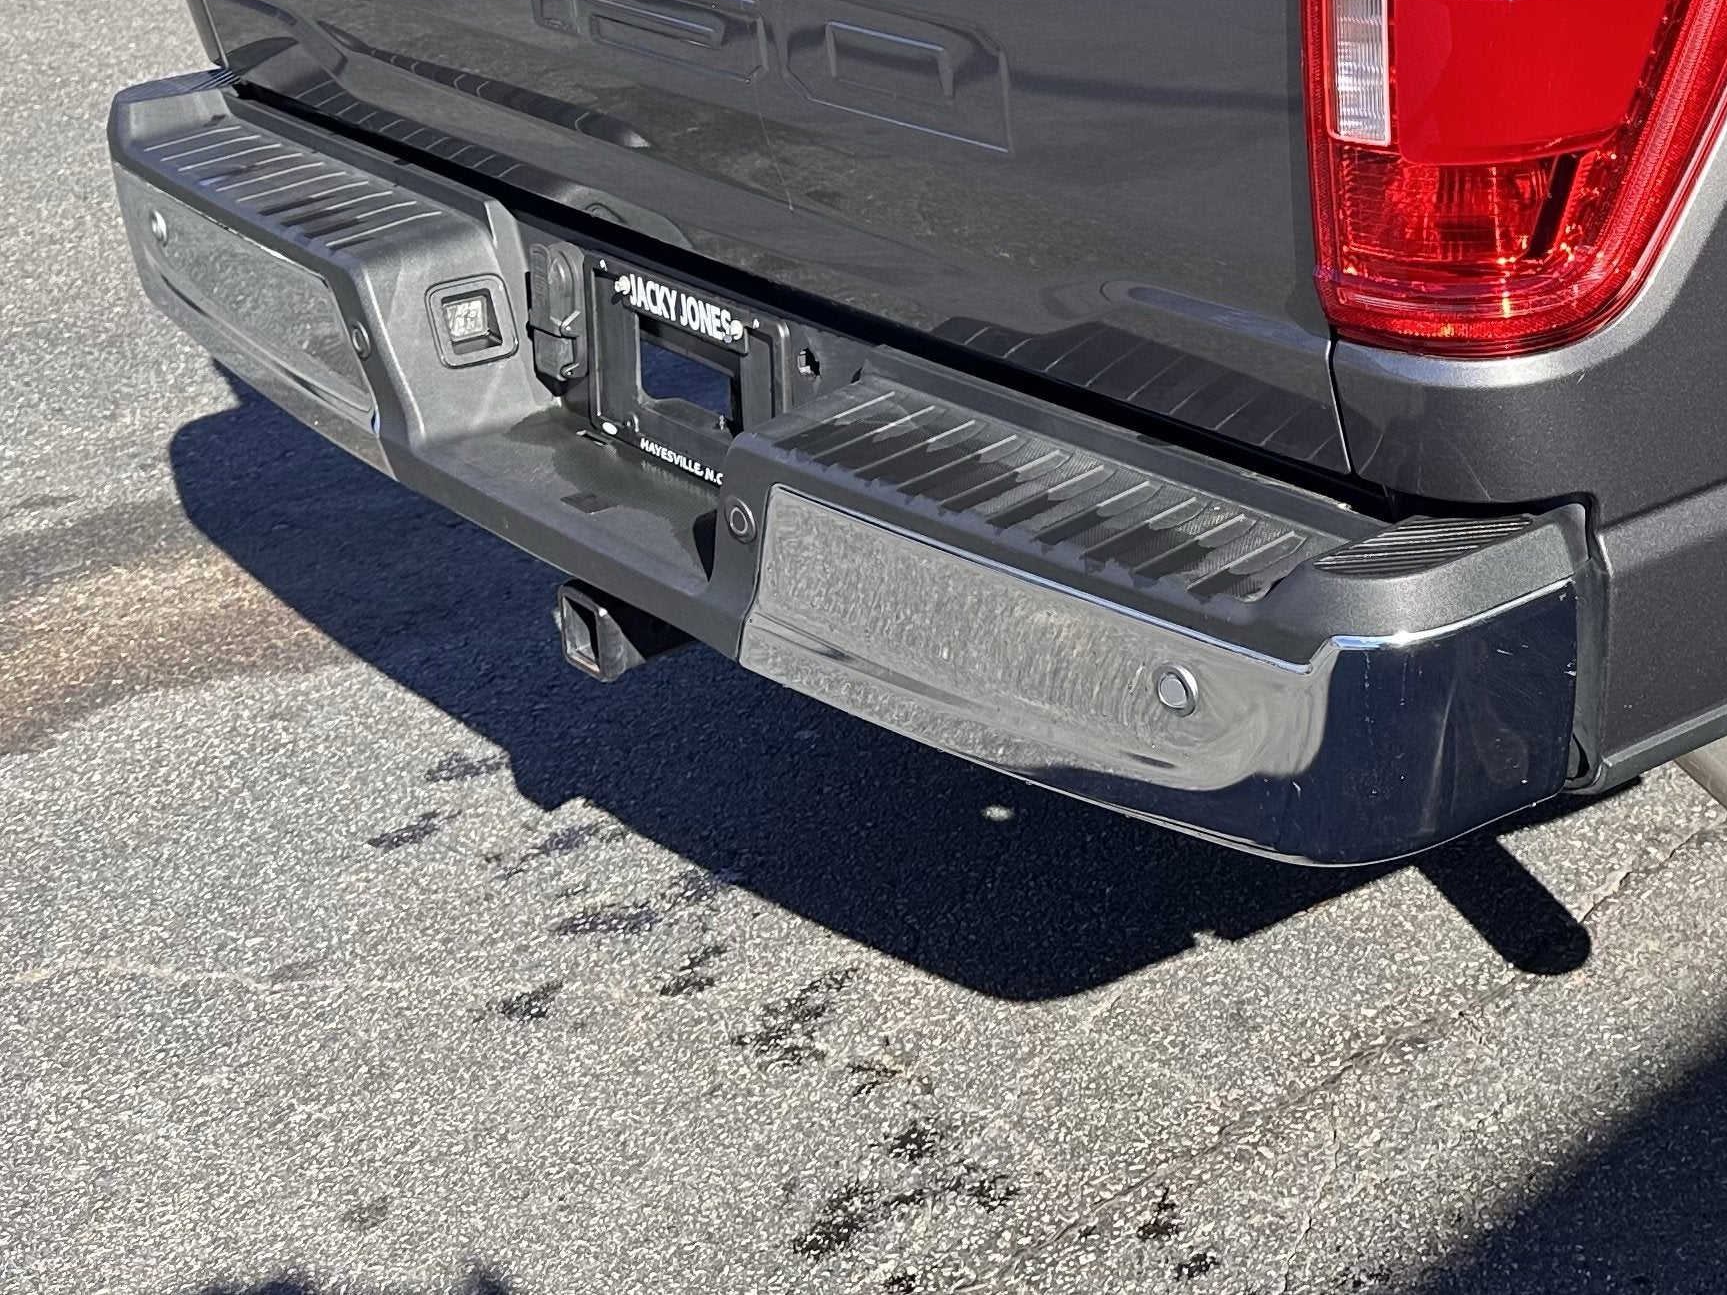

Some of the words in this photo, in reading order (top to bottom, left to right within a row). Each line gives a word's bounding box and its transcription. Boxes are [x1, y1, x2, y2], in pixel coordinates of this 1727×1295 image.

[629, 273, 677, 321] JACKY
[679, 293, 733, 341] JONES
[639, 437, 704, 477] HAYESVILLE,
